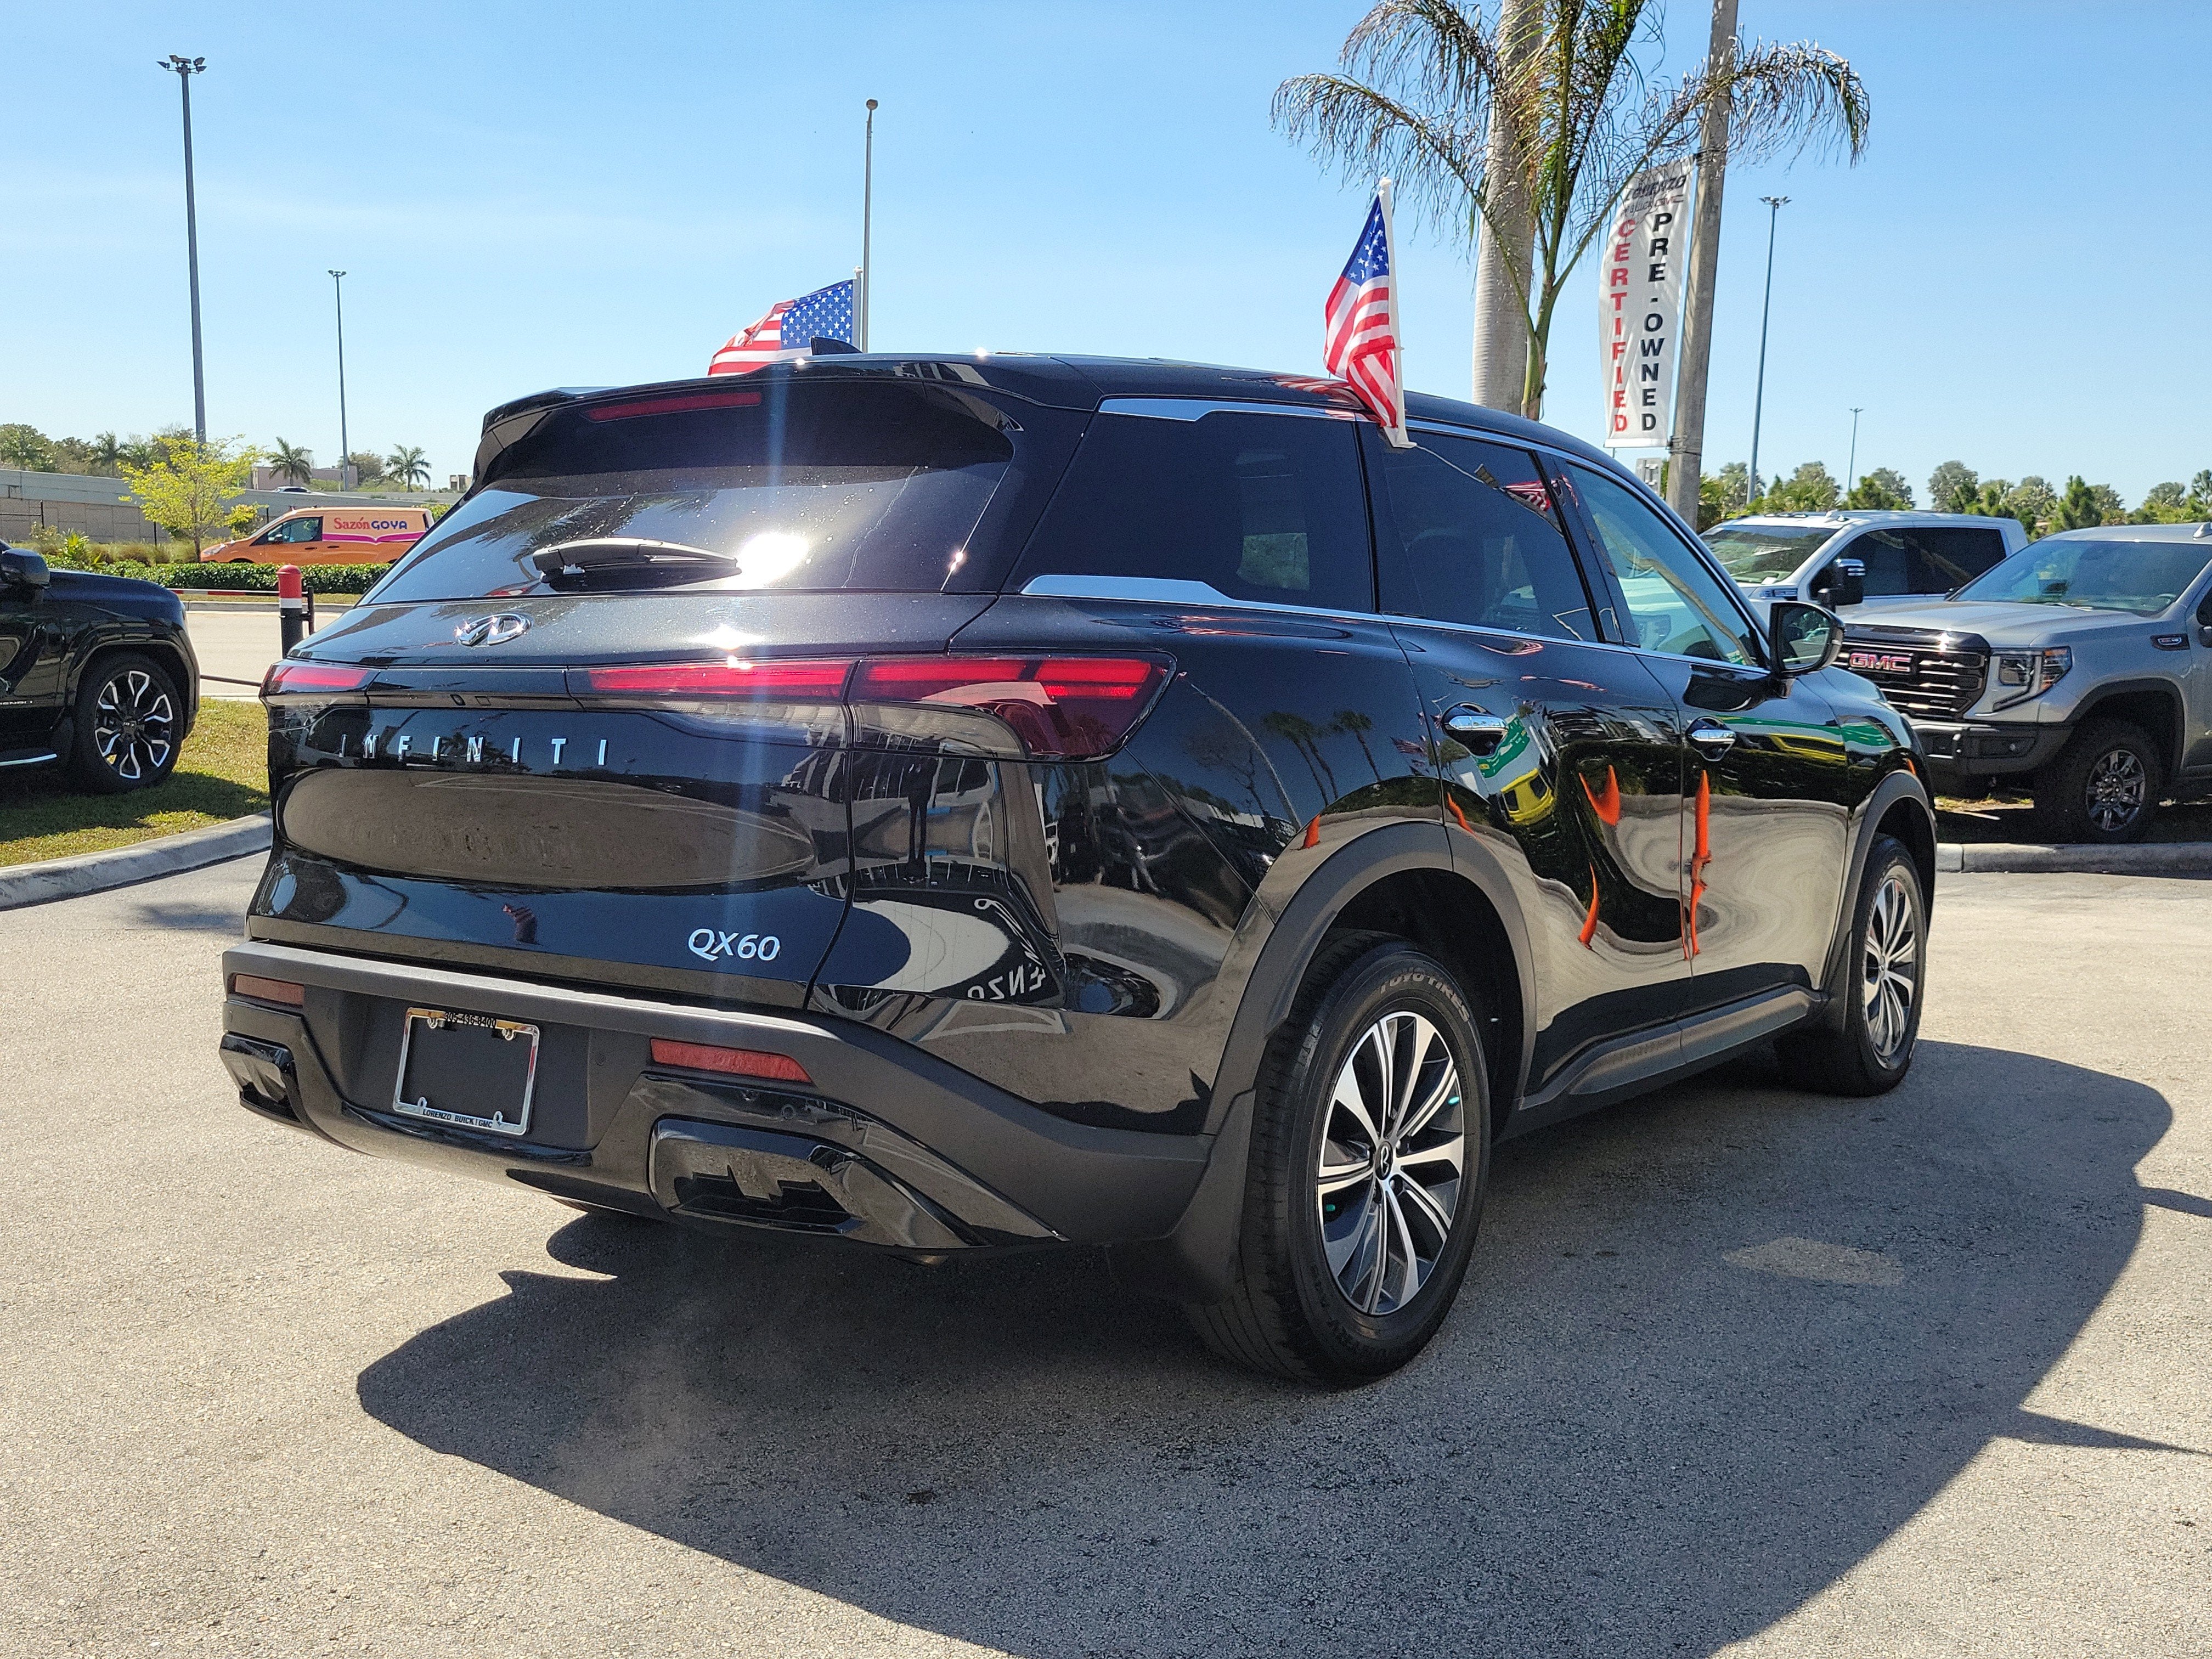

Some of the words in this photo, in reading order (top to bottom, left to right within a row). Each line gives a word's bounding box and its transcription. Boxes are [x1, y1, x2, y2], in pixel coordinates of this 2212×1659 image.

[1610, 219, 1636, 432] CERTIFIED
[334, 517, 370, 529] Sazón
[371, 520, 408, 531] GOYA
[1850, 652, 1912, 672] GMC
[339, 733, 607, 765] INFINITI
[689, 928, 780, 961] QX60
[422, 1109, 452, 1120] LORENZO
[454, 1115, 474, 1125] BUICK
[478, 1120, 493, 1128] GMC
